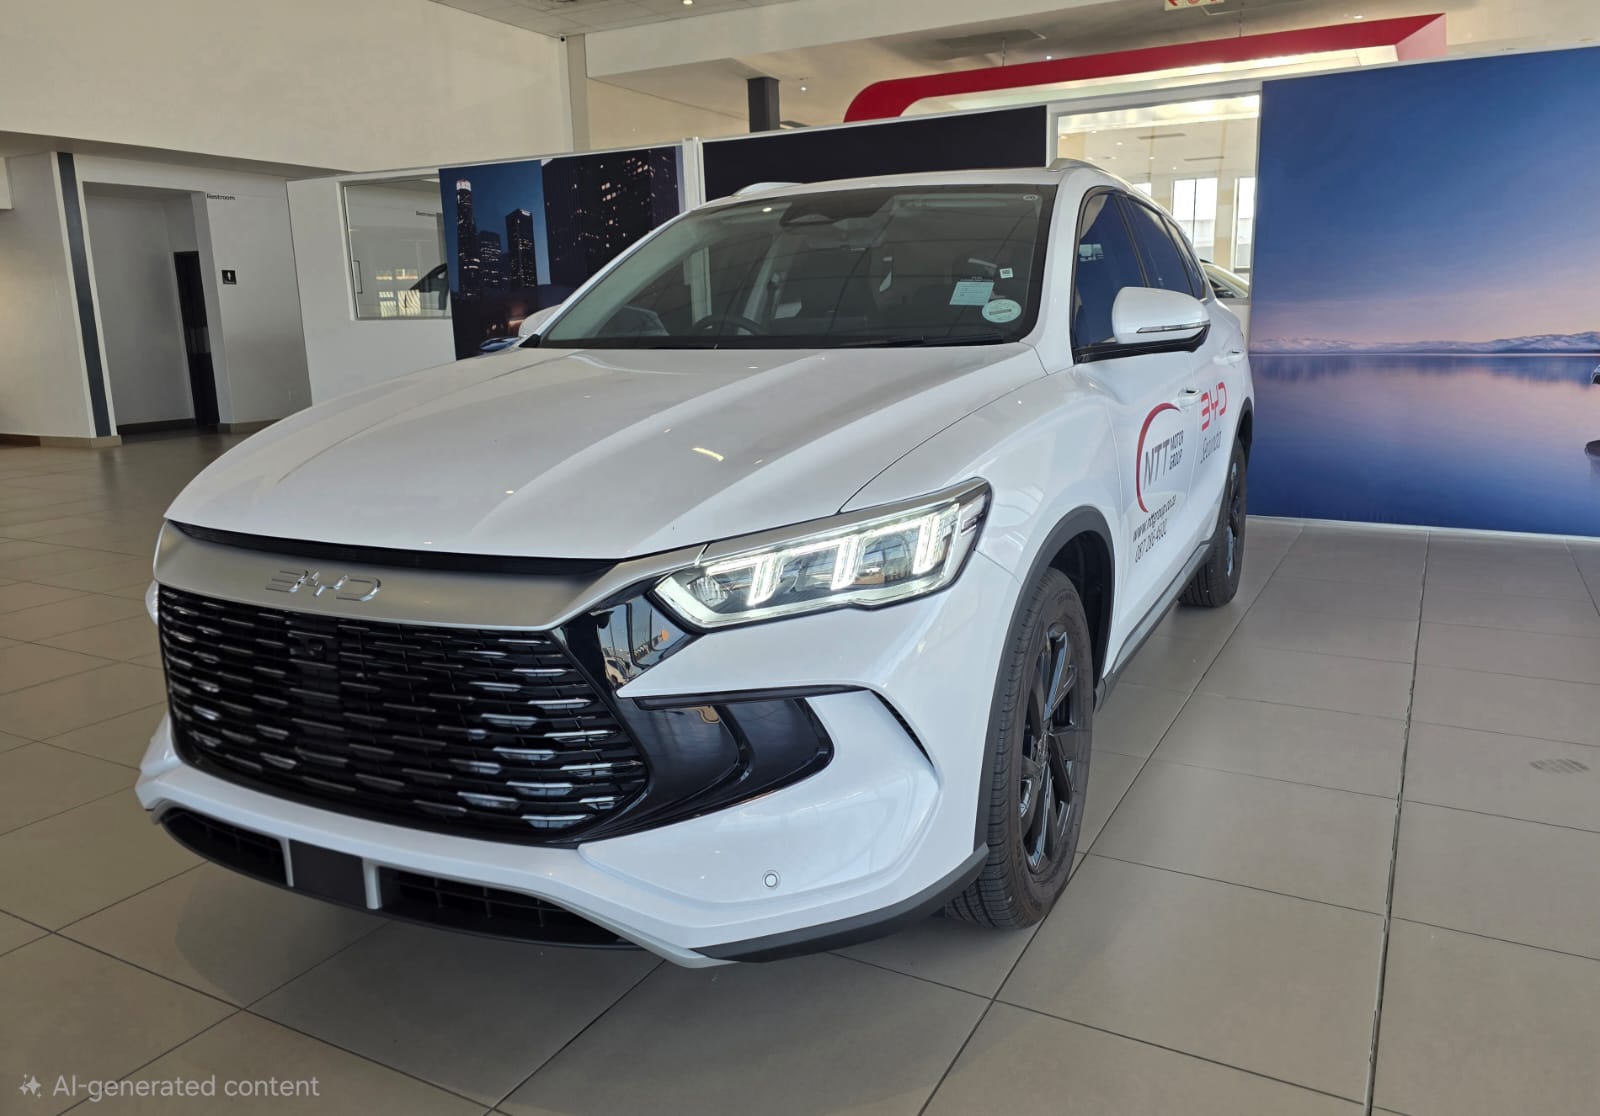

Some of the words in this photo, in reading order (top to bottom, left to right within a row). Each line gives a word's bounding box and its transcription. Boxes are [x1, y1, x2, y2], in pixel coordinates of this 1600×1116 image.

[1201, 381, 1227, 432] BYD
[1170, 429, 1184, 451] MOTOR
[1143, 438, 1170, 490] NTT
[1169, 448, 1183, 470] GROUP
[265, 568, 381, 602] BYD
